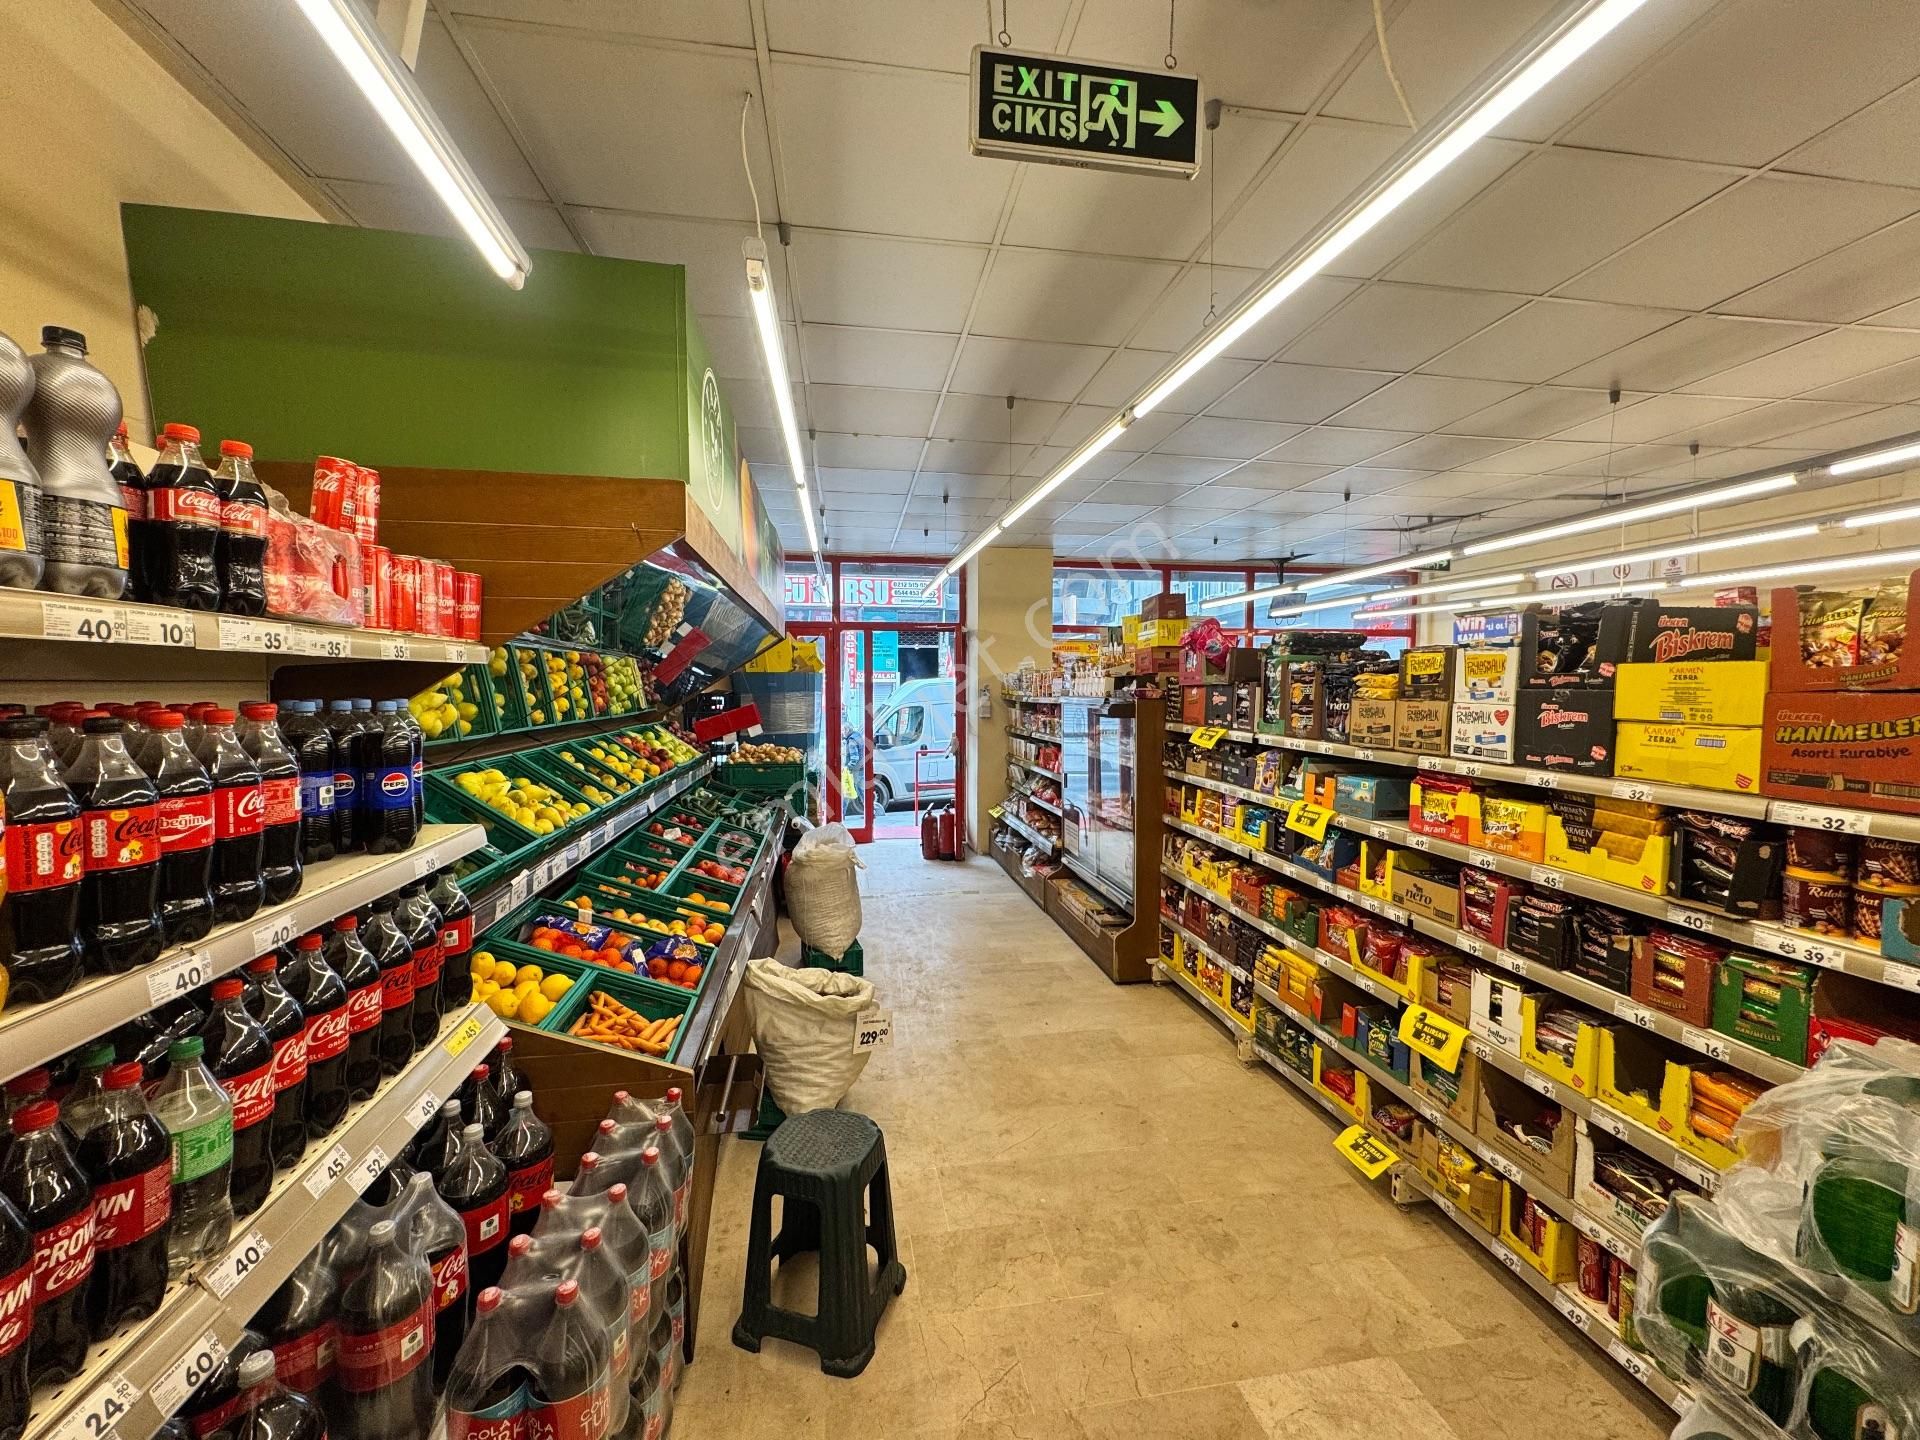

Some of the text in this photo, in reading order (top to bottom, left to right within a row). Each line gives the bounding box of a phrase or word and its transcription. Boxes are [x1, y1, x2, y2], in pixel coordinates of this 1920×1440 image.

[993, 63, 1079, 102] EXIT
[992, 102, 1078, 141] ÇIKIŞ
[77, 618, 112, 640] 40
[160, 623, 183, 644] 10
[264, 632, 282, 650] 35
[1650, 626, 1734, 663] Biskrem
[327, 640, 341, 657] 35
[393, 645, 405, 659] 35
[1537, 709, 1588, 728] Biskrem
[1777, 709, 1822, 723] ÜLKER
[1644, 726, 1685, 737] KARMEN
[1647, 735, 1677, 744] ZEBRA
[1791, 746, 1912, 759] Asorti Kurabiye
[1427, 761, 1437, 770] 36
[1466, 766, 1475, 775] 36
[333, 781, 354, 789] EPSI
[383, 780, 408, 790] PEPSI
[1538, 777, 1551, 787] 36
[1628, 789, 1644, 801] 32
[1821, 817, 1845, 831] 32
[1565, 826, 1593, 838] ARMEN
[1415, 839, 1424, 848] 49
[425, 858, 435, 872] 38
[1479, 859, 1491, 869] 49
[1544, 877, 1557, 887] 45
[1405, 889, 1432, 905] nero
[1683, 917, 1703, 930] 40
[271, 925, 290, 946] 40
[1468, 943, 1476, 953] 19
[1803, 949, 1824, 963] 39
[1511, 962, 1520, 972] 18
[175, 966, 201, 991] 40
[348, 986, 382, 1018] Coca
[1634, 1014, 1647, 1026] 16
[305, 1014, 349, 1046] Coca
[465, 1026, 477, 1040] 45
[860, 1030, 877, 1046] 229
[1475, 1046, 1487, 1058] 20
[1704, 1044, 1718, 1056] 16
[421, 1100, 436, 1117] 49
[1429, 1113, 1438, 1123] 55
[1613, 1125, 1620, 1136] 9
[327, 1157, 345, 1180] 45
[366, 1158, 385, 1178] 52
[1503, 1165, 1512, 1176] 55
[1700, 1174, 1712, 1189] 11
[1615, 1198, 1648, 1226] halle
[1606, 1239, 1619, 1253] 55
[235, 1246, 261, 1276] 40
[1502, 1253, 1515, 1267] 29
[1567, 1308, 1583, 1324] 49
[186, 1352, 214, 1388] 60
[1623, 1358, 1641, 1375] 59
[85, 1398, 125, 1437] 24
